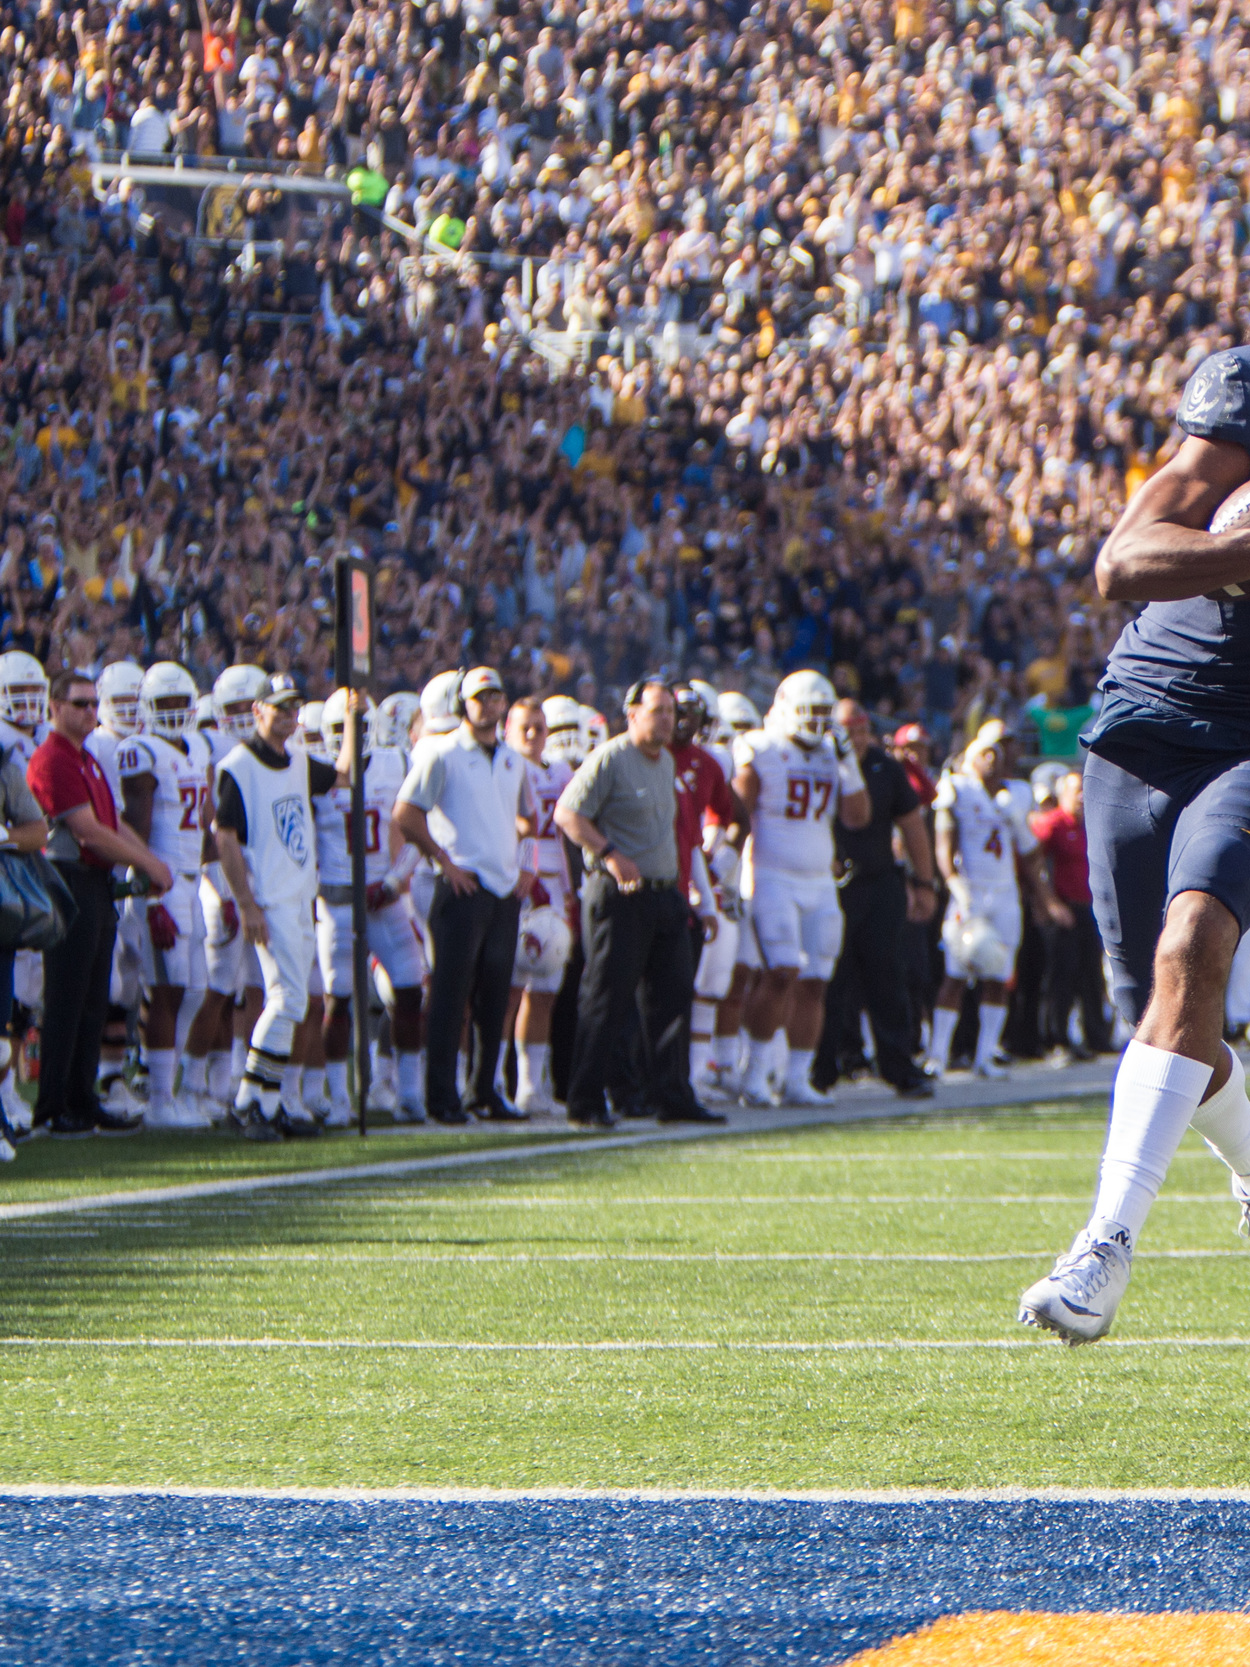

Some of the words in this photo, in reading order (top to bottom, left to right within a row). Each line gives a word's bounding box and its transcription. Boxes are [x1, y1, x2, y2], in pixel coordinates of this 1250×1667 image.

[118, 748, 138, 770] 20
[785, 780, 833, 821] 97
[984, 829, 1002, 859] 4
